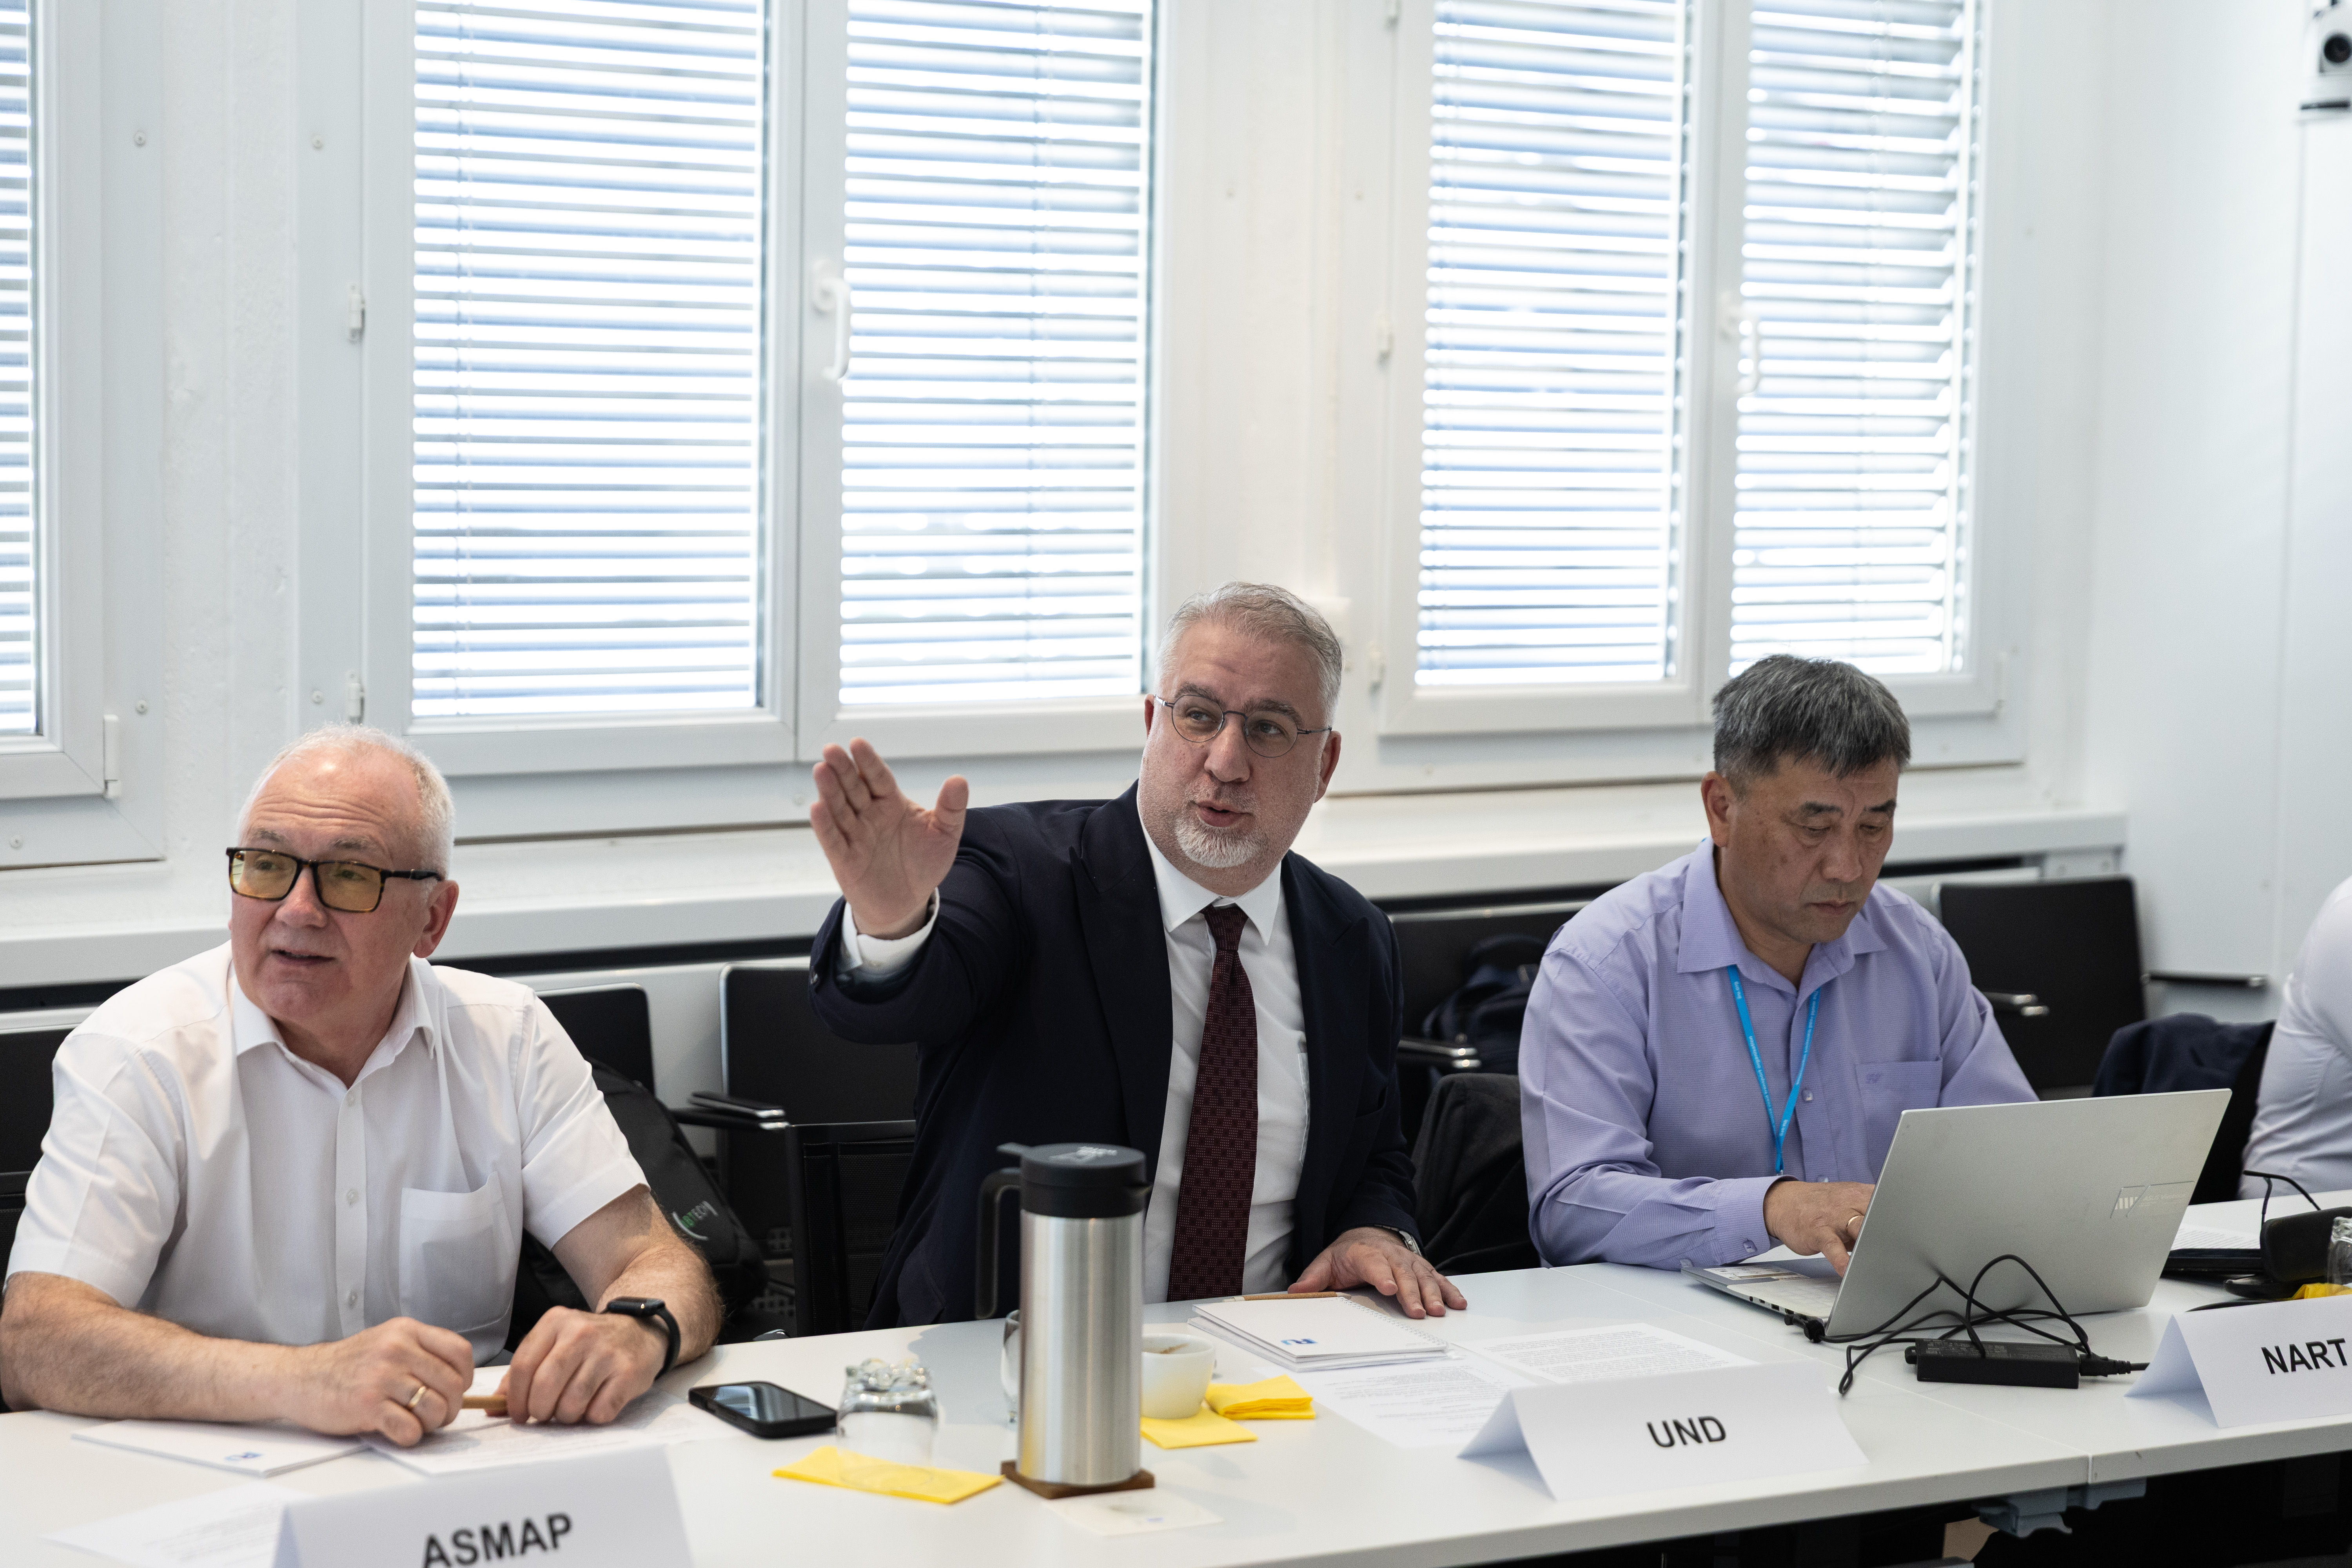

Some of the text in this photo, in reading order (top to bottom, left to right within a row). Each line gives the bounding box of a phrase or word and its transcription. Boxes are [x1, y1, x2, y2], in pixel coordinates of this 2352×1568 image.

[1749, 1036, 1761, 1069] organisation
[2261, 1338, 2349, 1375] NART
[1647, 1415, 1727, 1448] UND
[422, 1512, 573, 1568] ASMAP
